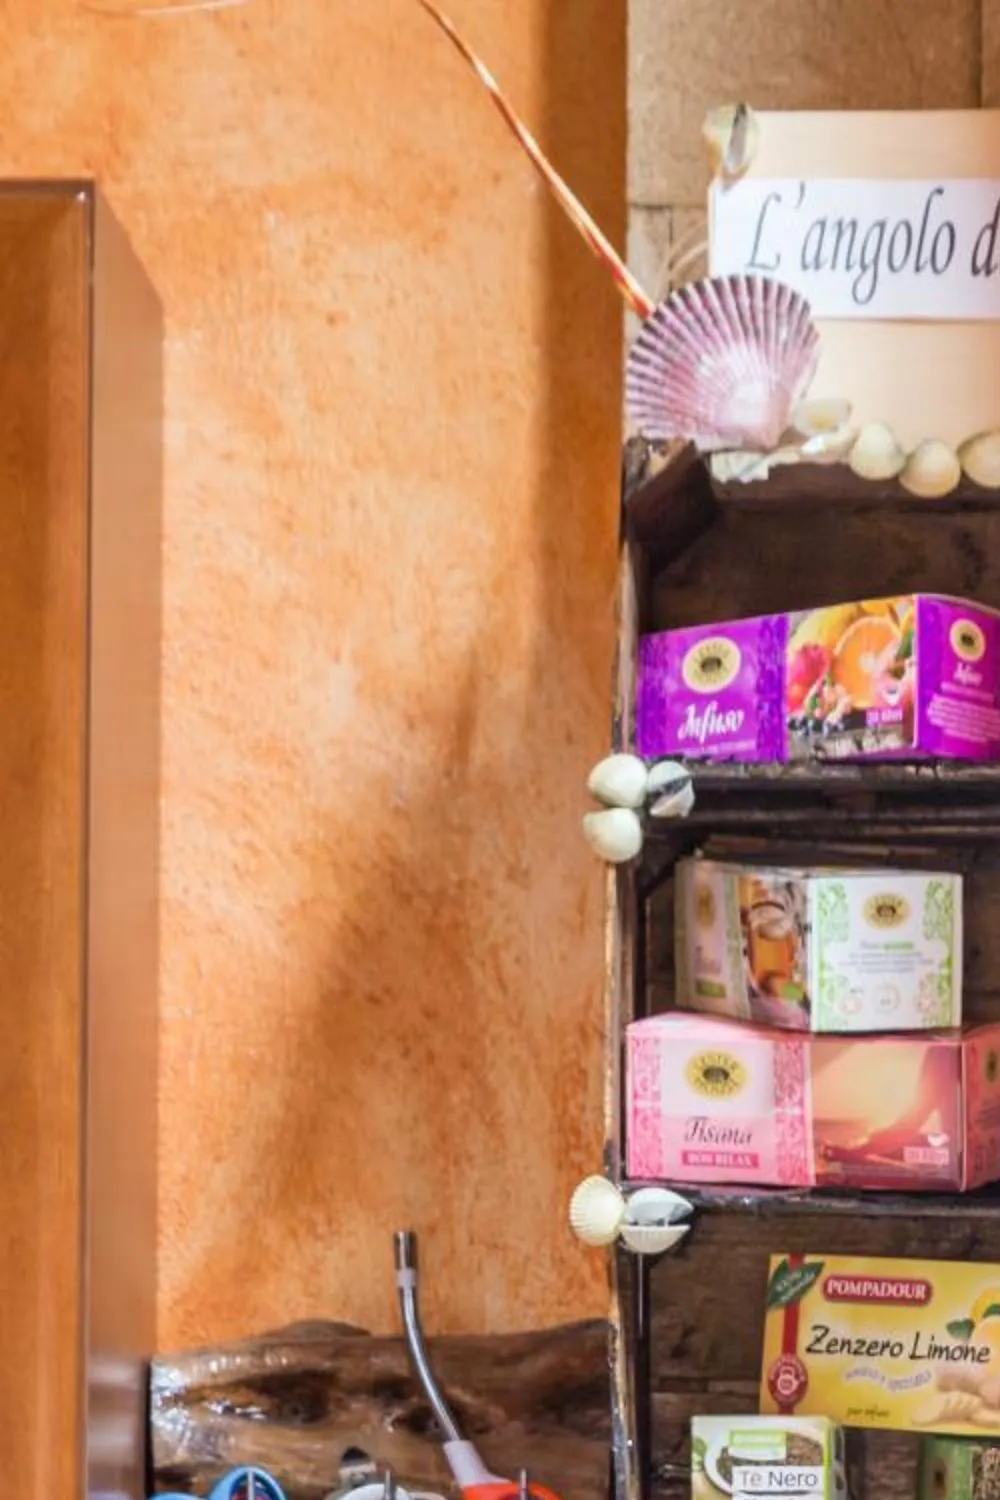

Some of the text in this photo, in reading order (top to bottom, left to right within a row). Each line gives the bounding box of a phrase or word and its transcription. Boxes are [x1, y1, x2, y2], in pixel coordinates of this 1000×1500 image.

[744, 182, 956, 304] L'angolo
[684, 1115, 753, 1147] Tisana
[826, 1280, 928, 1301] POMPADOUR
[805, 1324, 992, 1365] Zenzero Limone
[768, 1470, 818, 1488] Nero
